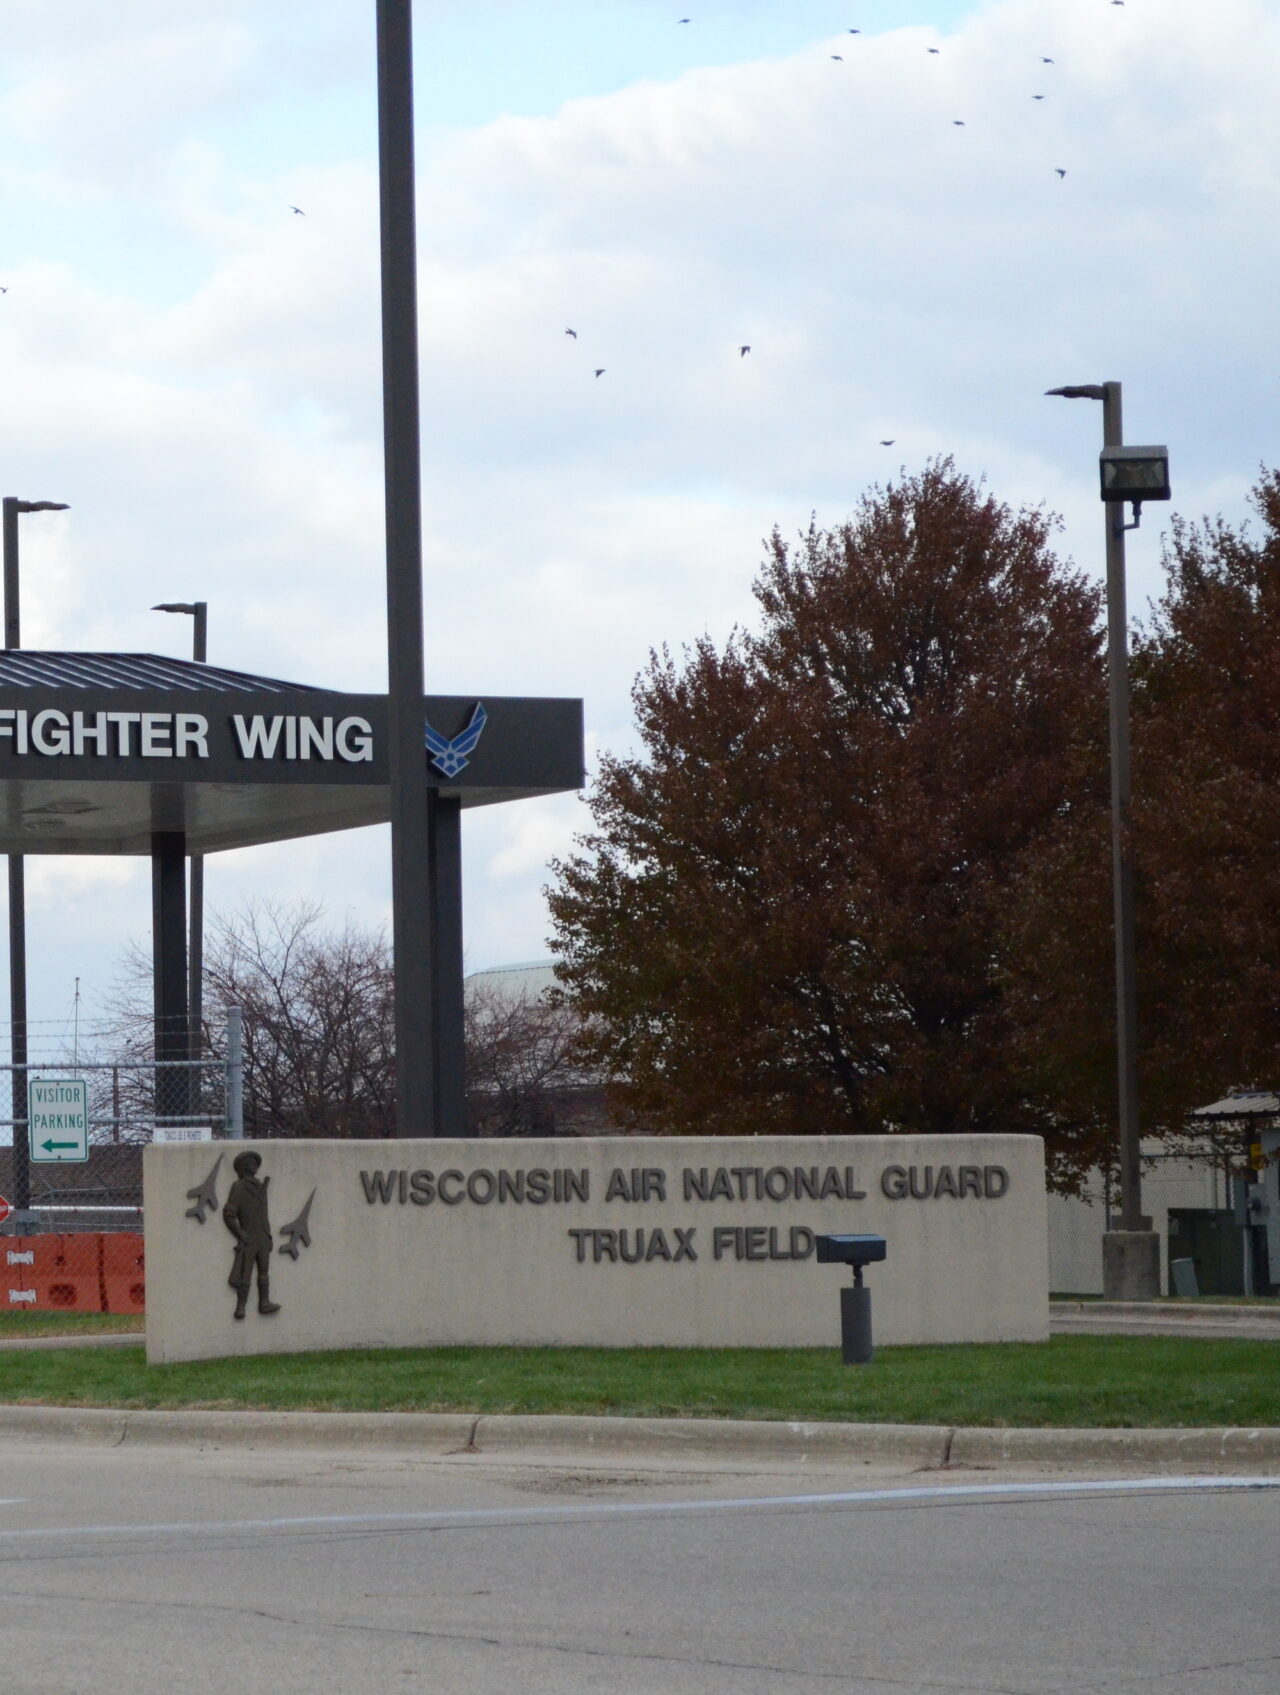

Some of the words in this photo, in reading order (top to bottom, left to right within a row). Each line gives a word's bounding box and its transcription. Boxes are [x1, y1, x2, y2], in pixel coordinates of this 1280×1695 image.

[233, 714, 374, 762] WING
[35, 1087, 80, 1103] VISITOR
[34, 1113, 84, 1129] PARKING
[360, 1168, 591, 1206] WISCONSIN
[605, 1167, 668, 1203] AIR
[682, 1165, 868, 1203] NATIONAL
[880, 1164, 1011, 1201] GUARD
[568, 1226, 698, 1263] TRUAX
[712, 1225, 816, 1262] FIELD
